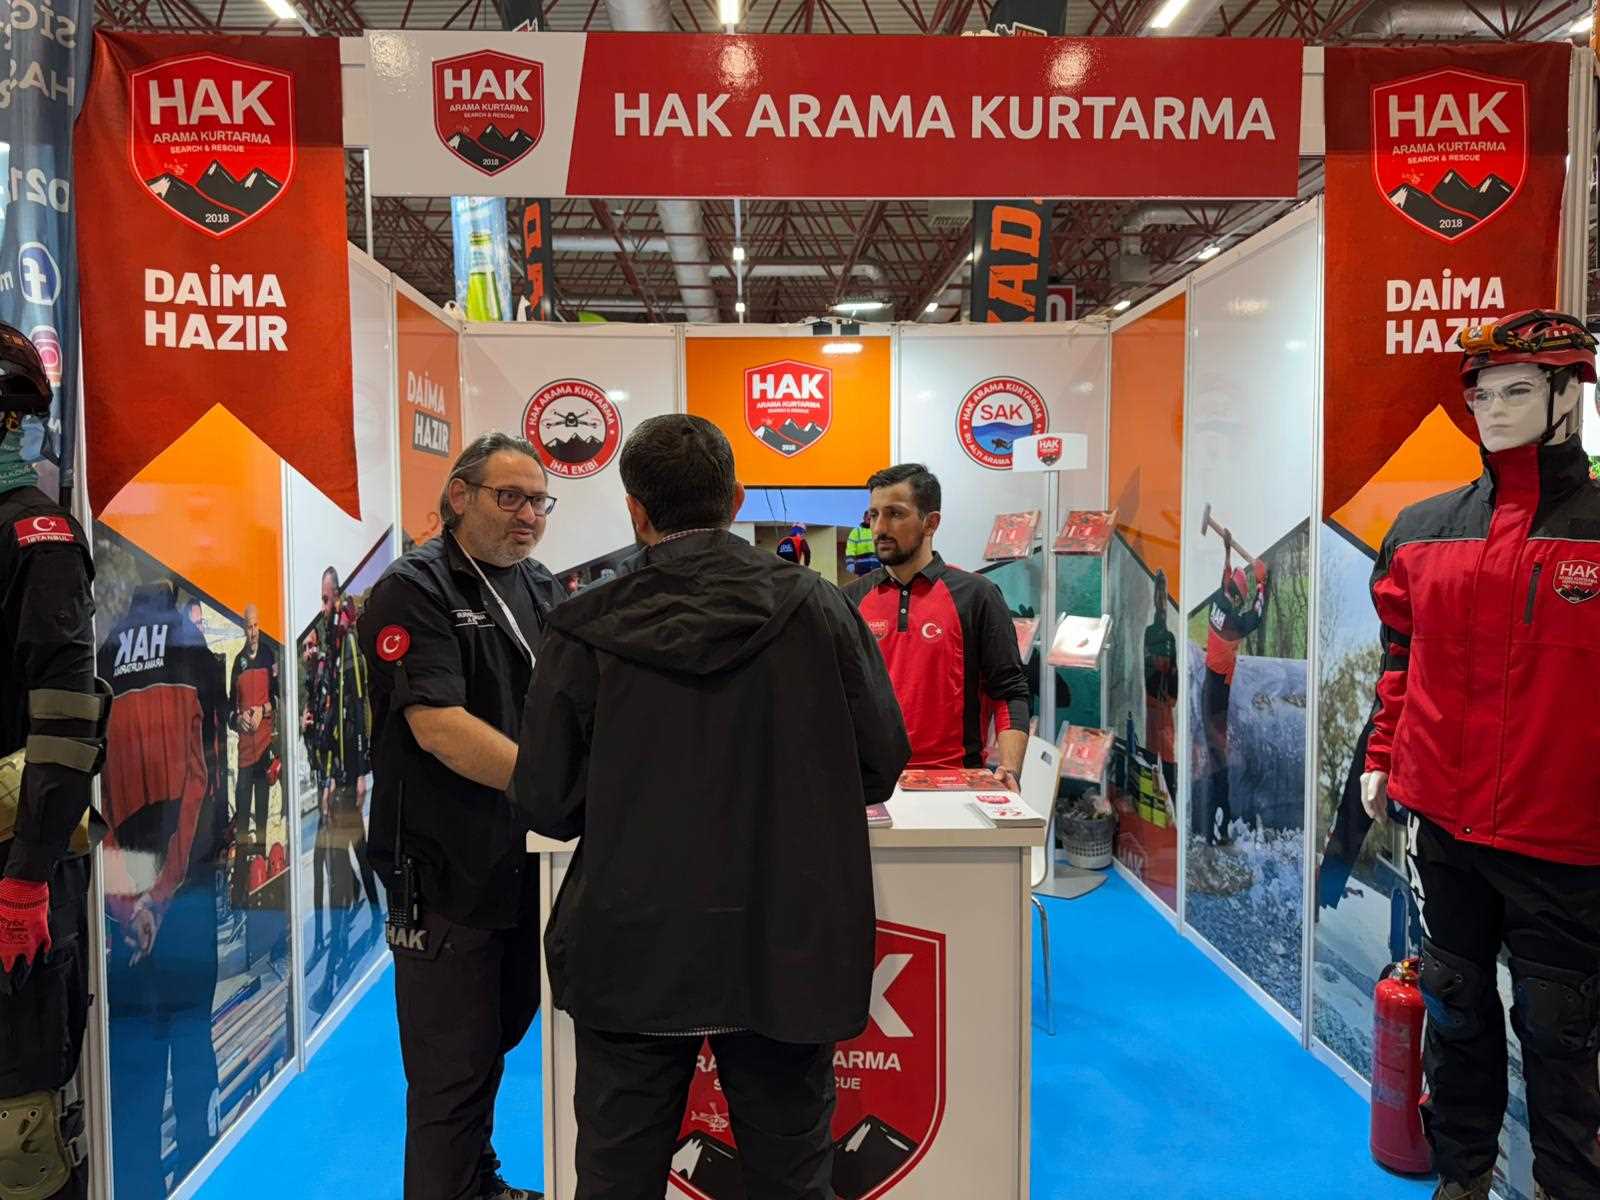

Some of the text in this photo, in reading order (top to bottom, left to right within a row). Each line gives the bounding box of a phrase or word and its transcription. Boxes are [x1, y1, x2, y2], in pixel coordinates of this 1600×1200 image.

[443, 68, 533, 101] HAK
[149, 78, 276, 126] HAK
[449, 103, 529, 113] ARAMA KURTARMA
[1388, 91, 1511, 138] HAK
[613, 93, 1276, 141] HAK ARAMA KURTARMA
[152, 130, 271, 145] ARAMA KURTARMA
[170, 144, 202, 155] SEARCH
[211, 143, 245, 153] RESCUE
[1392, 141, 1506, 156] ARAMA KURTARMA
[1407, 155, 1440, 164] SEARCH
[1448, 154, 1480, 162] RESCUE
[205, 212, 230, 223] 2018
[1439, 218, 1463, 228] 2018
[144, 263, 287, 308] DAİMA
[1386, 268, 1505, 312] DAİMA
[144, 309, 288, 352] HAZIR
[407, 370, 446, 416] DAİMA
[752, 373, 825, 400] HAK
[528, 385, 615, 426] HAK ARAMA KURTARMA
[980, 403, 1024, 421] SAK
[414, 412, 449, 453] HAZIR
[1560, 563, 1600, 579] HAK
[386, 924, 427, 951] HAK
